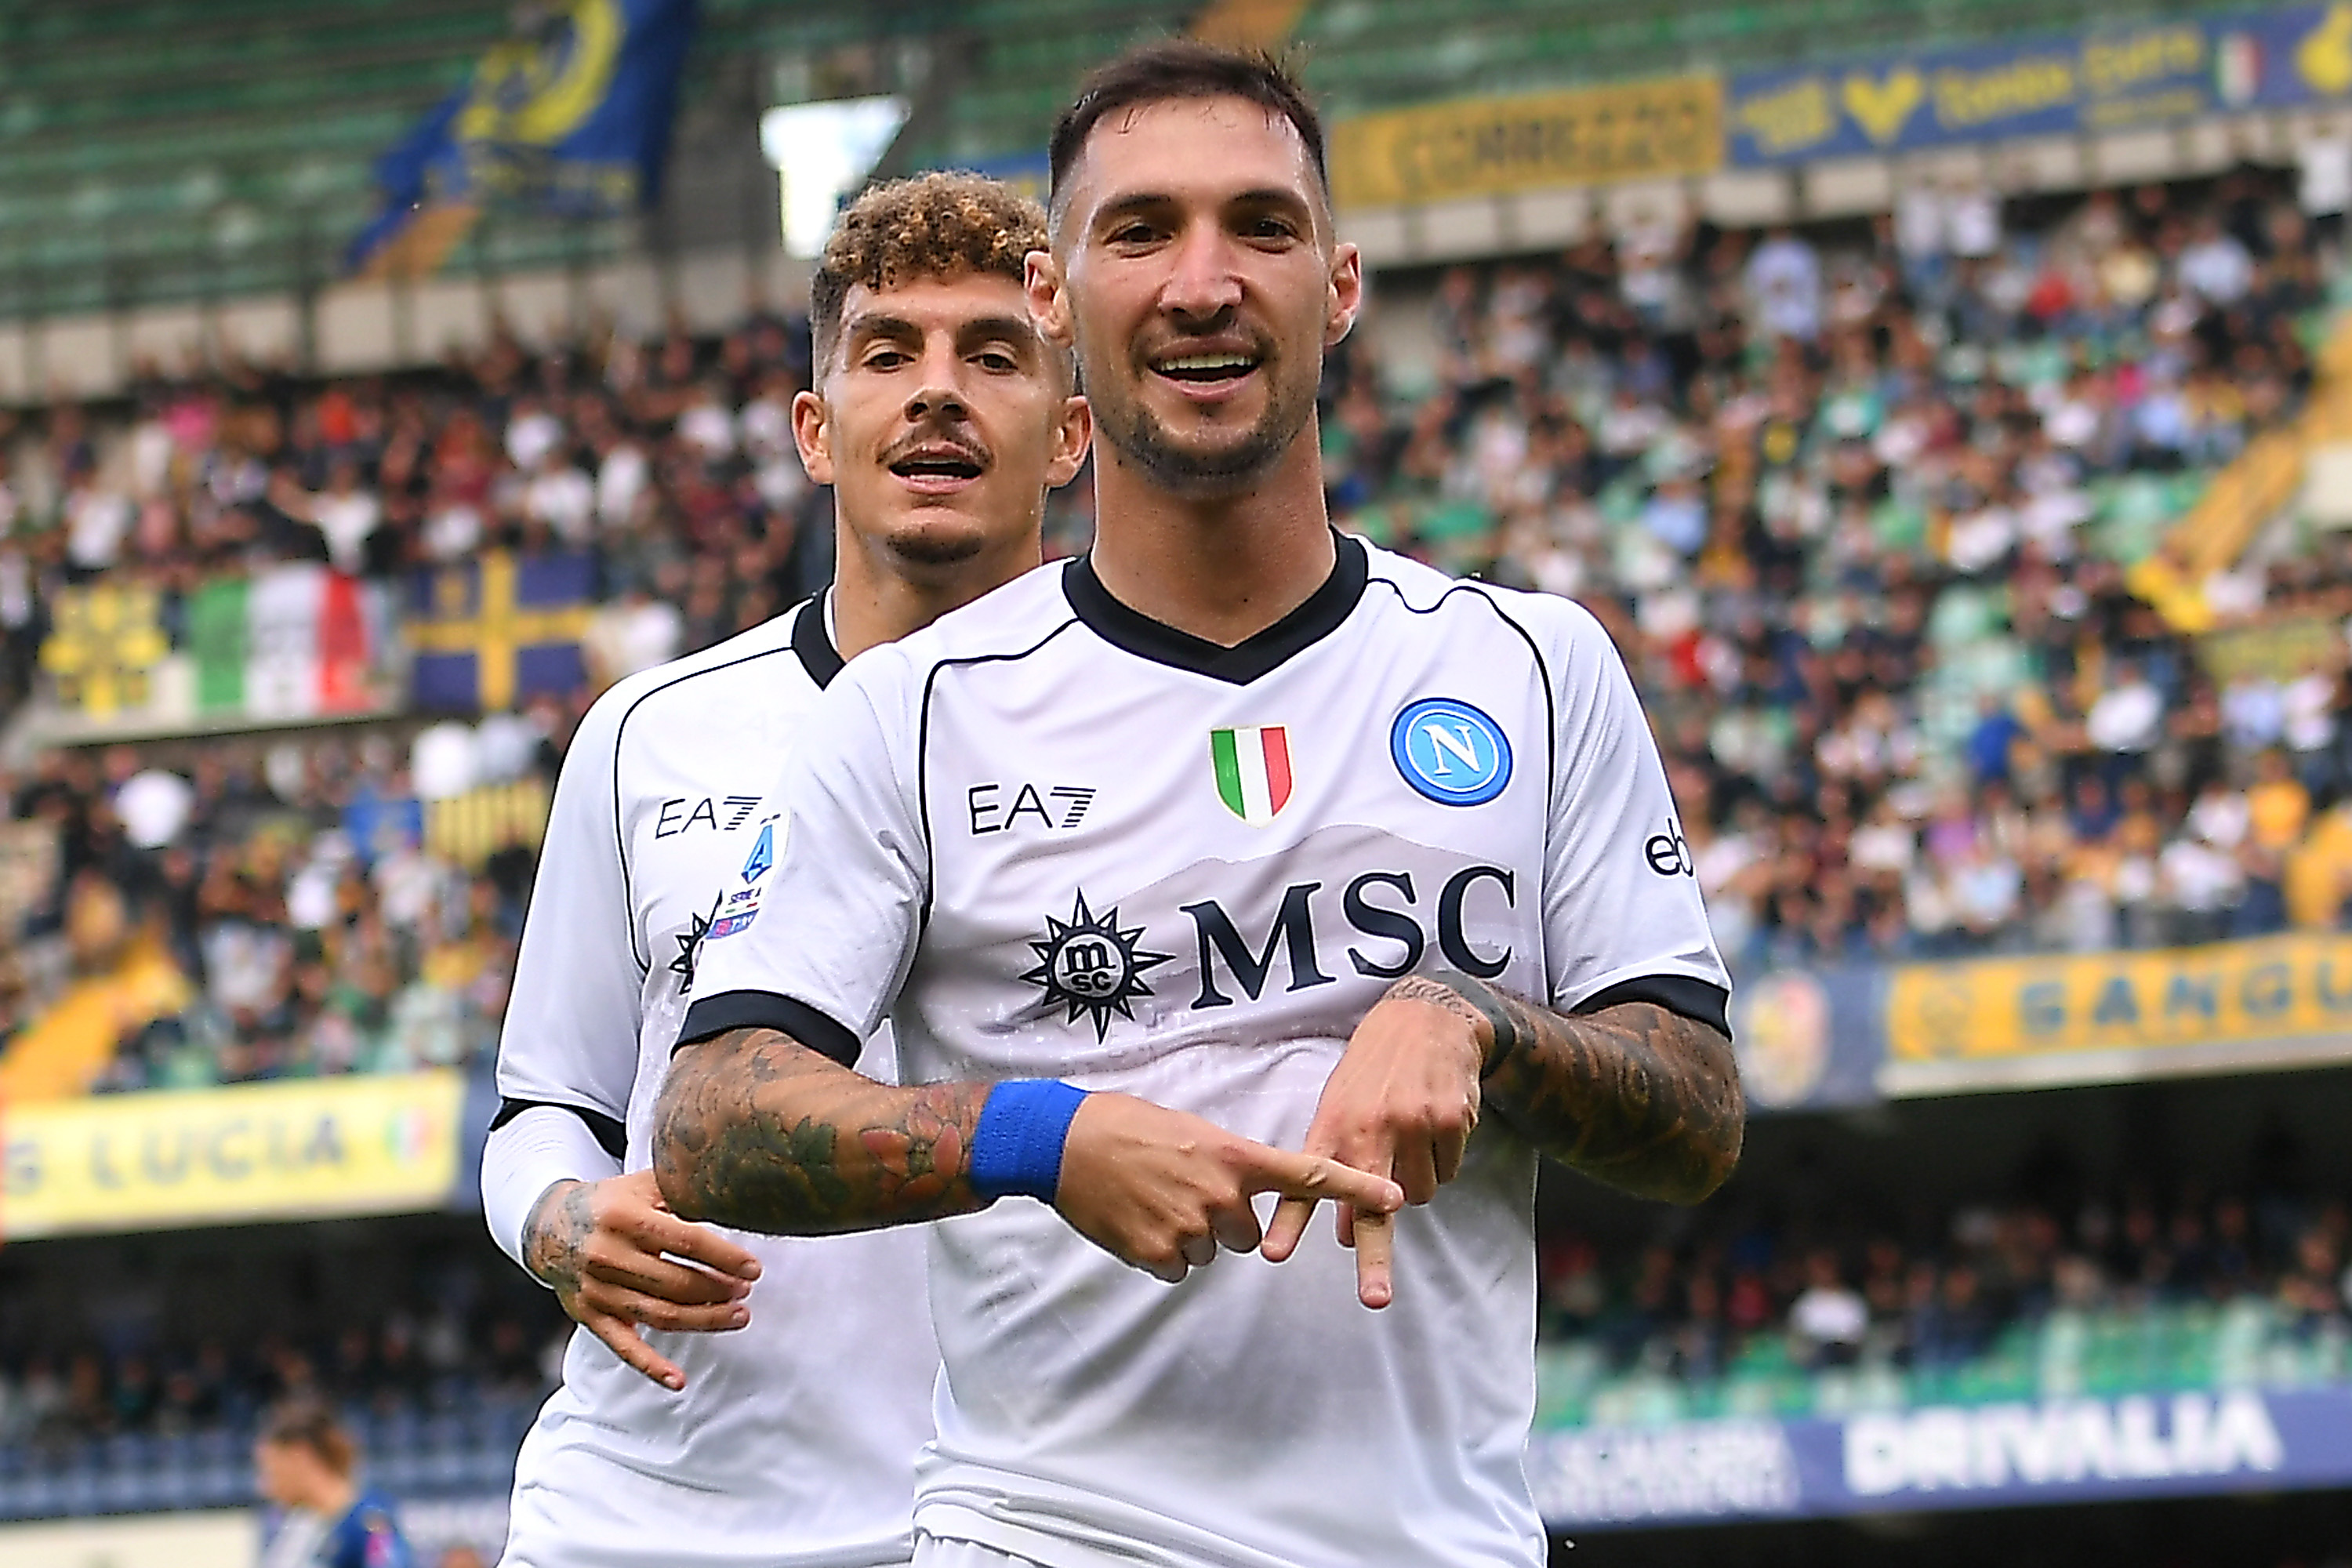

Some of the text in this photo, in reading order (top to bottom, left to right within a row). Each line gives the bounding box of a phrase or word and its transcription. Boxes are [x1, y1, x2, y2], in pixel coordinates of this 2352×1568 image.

[1422, 724, 1481, 776] N
[655, 795, 763, 840] EA7
[968, 783, 1097, 836] EA7
[1179, 865, 1515, 1011] MSC
[88, 1112, 347, 1192] LUCIA
[1844, 1394, 2284, 1494] DRIVALIA
